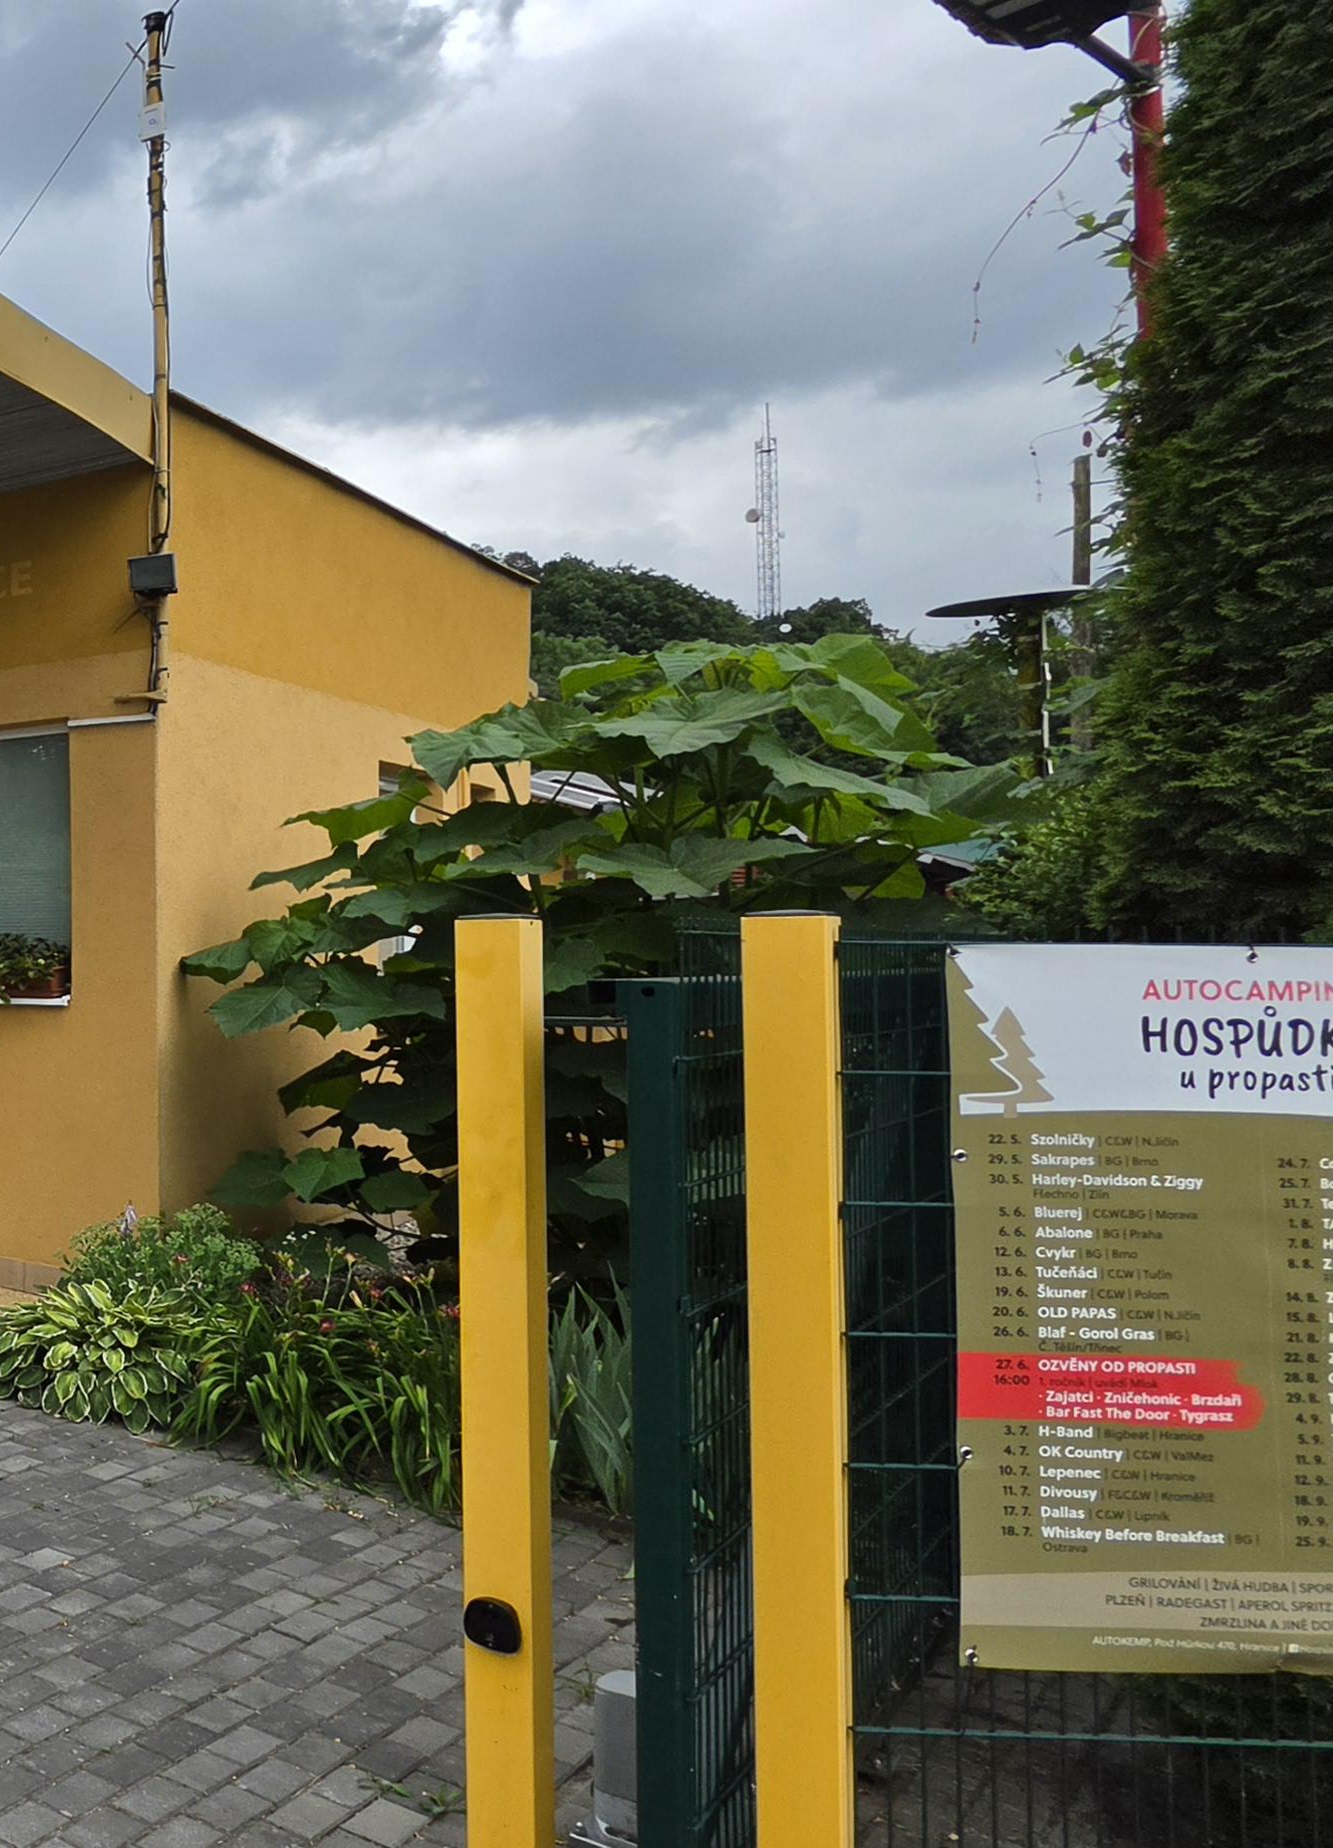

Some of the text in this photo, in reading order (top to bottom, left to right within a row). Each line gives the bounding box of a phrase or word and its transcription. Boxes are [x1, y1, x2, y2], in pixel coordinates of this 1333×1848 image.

[1180, 1070, 1195, 1088] u
[989, 1134, 1007, 1145] 22.
[1011, 1134, 1022, 1145] 5.
[1031, 1133, 1095, 1149] Szolničky
[989, 1154, 1159, 1168] 29. 5. Sakrapes BG Brno
[989, 1174, 1203, 1191] 30. 5. Harley-Davidson & Ziggy
[999, 1207, 1011, 1218] 5.
[1015, 1207, 1027, 1218] 6.
[1034, 1207, 1083, 1222] Bluerej
[999, 1226, 1163, 1240] 6. 6. Abalone BG Praha
[995, 1247, 1138, 1261] 12. 6. Cvykr BG Brno
[995, 1267, 1012, 1278] 13.
[1015, 1267, 1028, 1278] 6.
[1035, 1266, 1098, 1279] Tučeňáci
[995, 1287, 1013, 1298] 19.
[1015, 1287, 1029, 1298] 6.
[1037, 1282, 1088, 1299] Škuner
[993, 1306, 1013, 1318] 20.
[1017, 1306, 1029, 1318] 6.
[1037, 1307, 1067, 1318] OLD
[1072, 1307, 1117, 1319] PAPAS
[993, 1327, 1014, 1338] 26.
[1017, 1327, 1029, 1338] 6.
[1038, 1326, 1067, 1339] Blaf
[1079, 1327, 1119, 1340] Gorol
[1122, 1328, 1156, 1341] Gras
[1165, 1330, 1182, 1341] BG
[996, 1358, 1197, 1376] 27. 6. OZVĚNY OD PROPASTI
[993, 1375, 1030, 1386] 16:00
[1045, 1390, 1093, 1406] Zajatci
[1103, 1391, 1182, 1406] Zničehonic
[1046, 1406, 1233, 1426] Bar Fast The Door Tygrasz
[1004, 1426, 1017, 1436] 3.
[1019, 1426, 1029, 1436] 7.
[1039, 1426, 1093, 1438] H-Band
[1003, 1446, 1017, 1456] 4.
[1020, 1446, 1030, 1456] 7.
[1039, 1446, 1061, 1458] OK
[1065, 1446, 1125, 1463] Country
[999, 1465, 1017, 1476] 10.
[1019, 1465, 1031, 1476] 7.
[1039, 1465, 1102, 1482] Lepenec
[1020, 1485, 1031, 1496] 7.
[1040, 1486, 1097, 1502] Divousy
[1021, 1506, 1032, 1516] 7.
[1041, 1506, 1086, 1519] Dallas
[1001, 1526, 1253, 1545] 18. 7. Whiskey Before Breakfast BG
[1042, 1542, 1089, 1554] Ostrava
[1129, 1576, 1201, 1590] GRILOVÁNÍ
[1213, 1578, 1239, 1592] ŽIVÁ
[1243, 1582, 1289, 1592] HUDBA
[1106, 1594, 1145, 1606] PLZEŇ
[1157, 1598, 1227, 1610] RADEGAST
[1238, 1600, 1288, 1612] APEROL
[1200, 1616, 1267, 1630] ZMRZLINA
[1270, 1618, 1279, 1630] A
